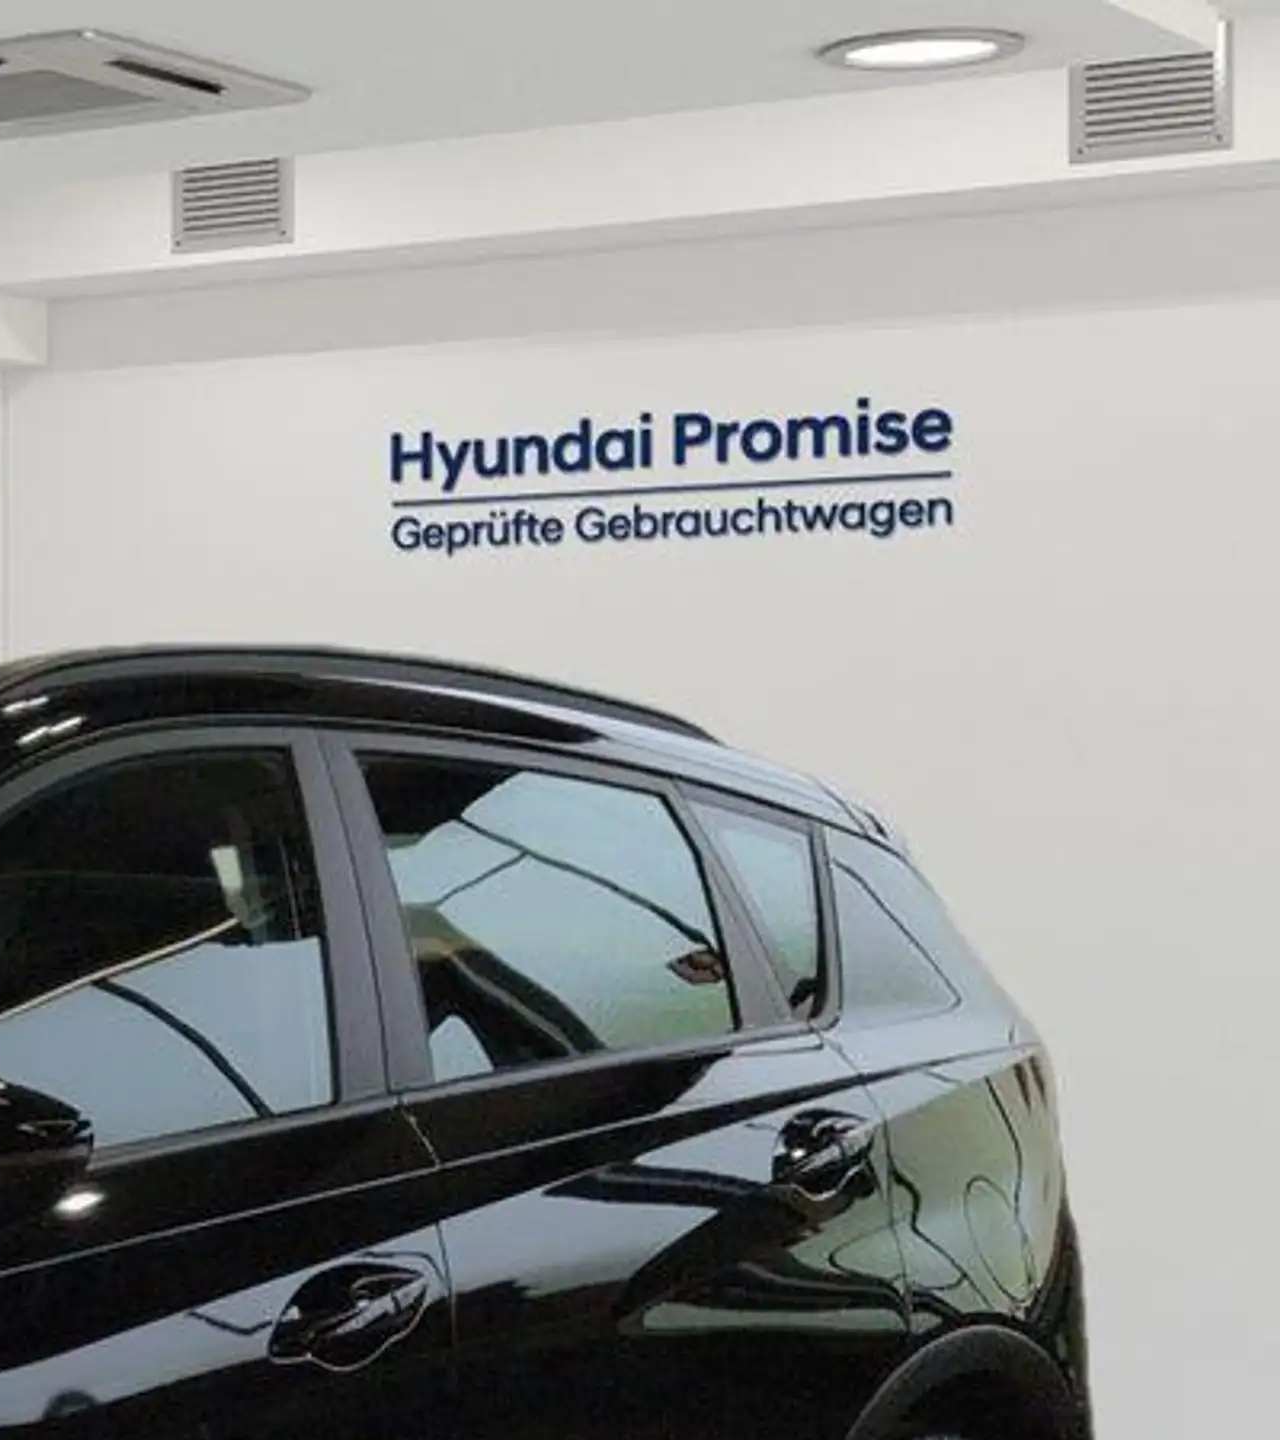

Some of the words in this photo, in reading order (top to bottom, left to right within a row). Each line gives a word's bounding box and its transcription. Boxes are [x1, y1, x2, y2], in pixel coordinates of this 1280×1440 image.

[390, 411, 654, 493] Hyundai
[673, 396, 954, 467] Promise
[390, 508, 566, 557] Geprüfte
[574, 496, 955, 544] Gebrauchtwagen
